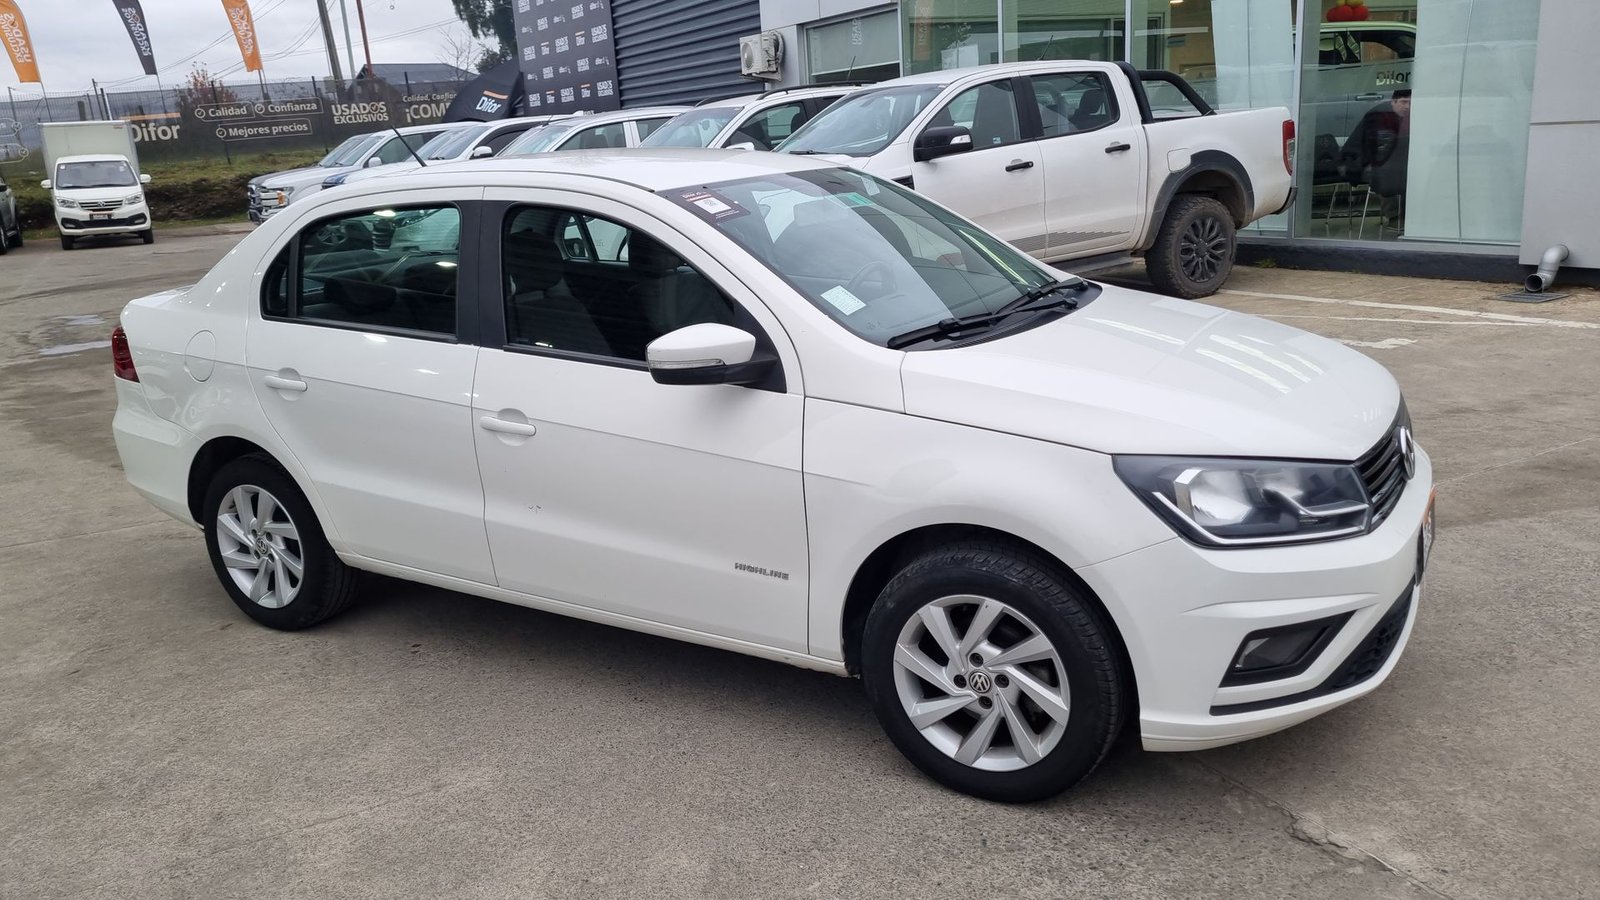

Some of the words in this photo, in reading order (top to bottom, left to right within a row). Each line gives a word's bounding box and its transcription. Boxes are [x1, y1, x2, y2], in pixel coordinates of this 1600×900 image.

[208, 106, 248, 118] Calidad
[268, 102, 318, 113] Confianza
[331, 101, 387, 116] USADOS
[475, 96, 501, 114] Difor
[333, 113, 389, 125] EXCLUSIVOS
[405, 103, 451, 123] ¡COM
[131, 122, 180, 142] Difor
[228, 124, 270, 138] Mejores
[272, 123, 308, 136] precios
